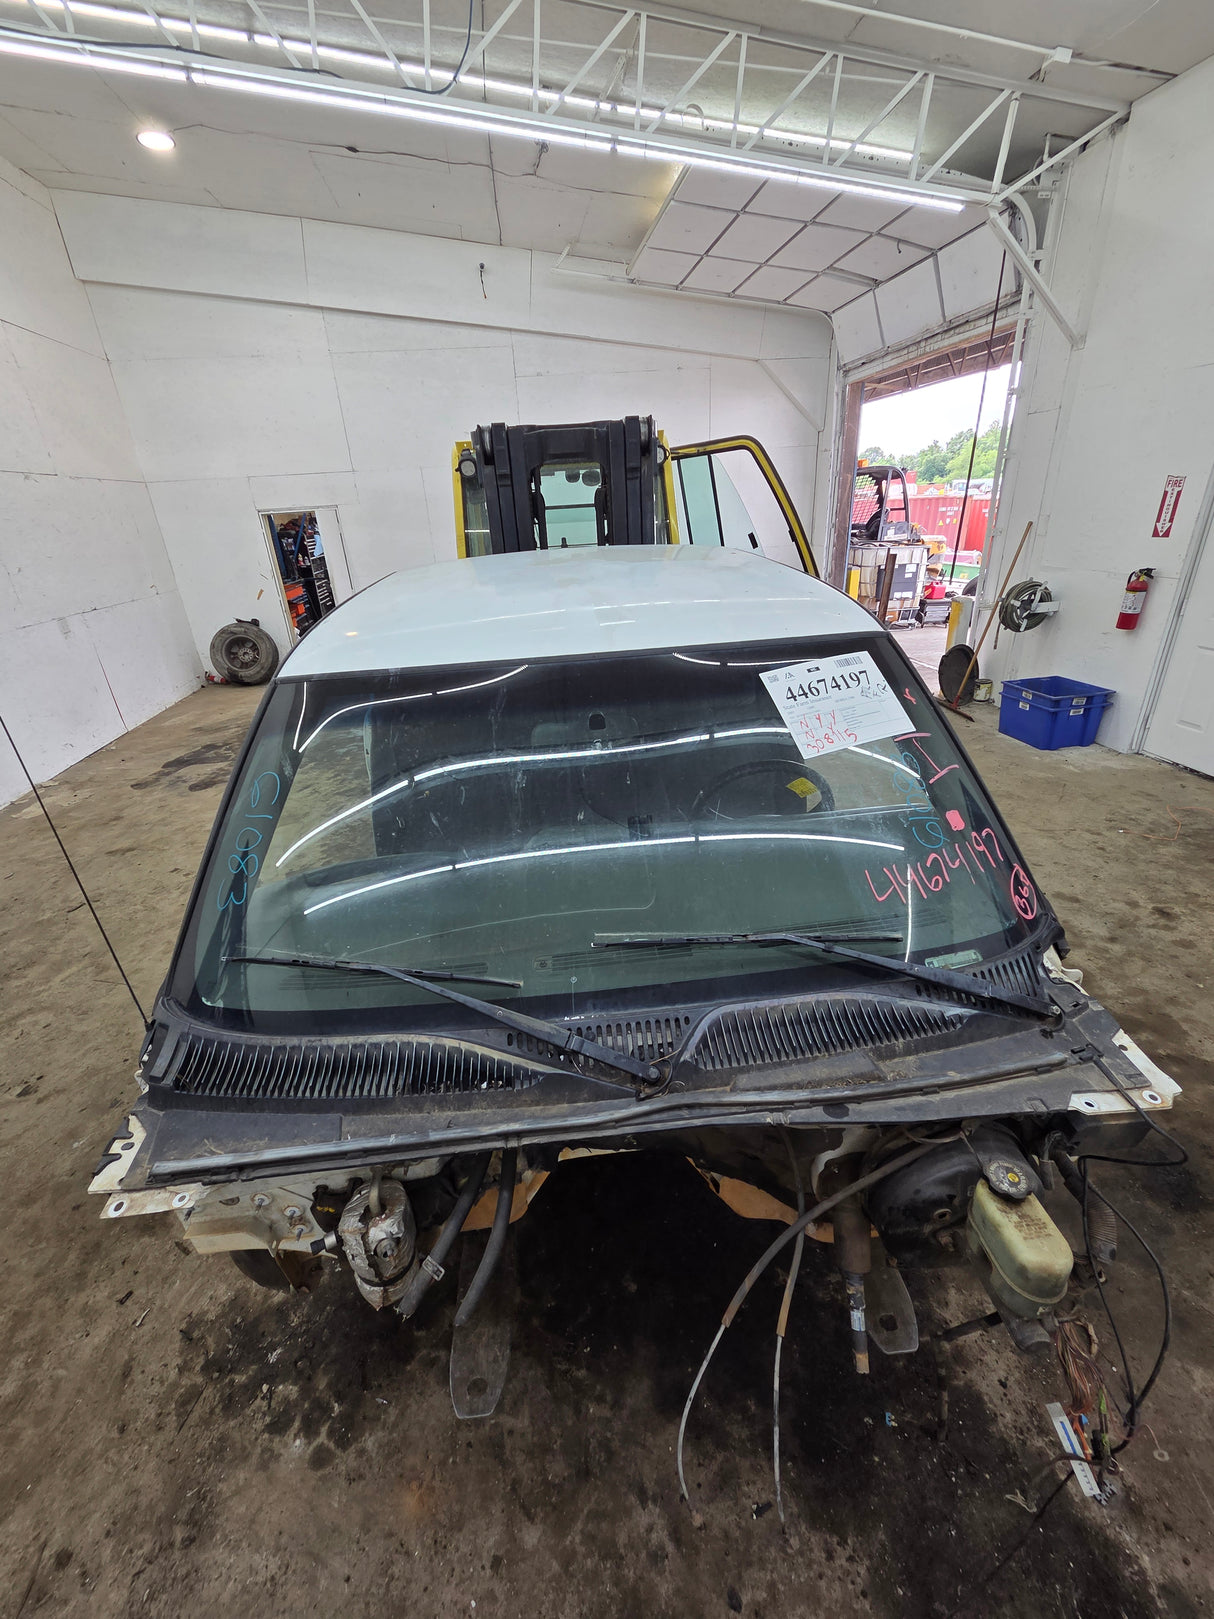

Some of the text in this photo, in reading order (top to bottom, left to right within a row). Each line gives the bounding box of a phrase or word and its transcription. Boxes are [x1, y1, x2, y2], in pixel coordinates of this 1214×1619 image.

[1167, 479, 1183, 488] FIRE
[785, 670, 870, 701] 44674197
[865, 827, 1004, 904] 44674197
